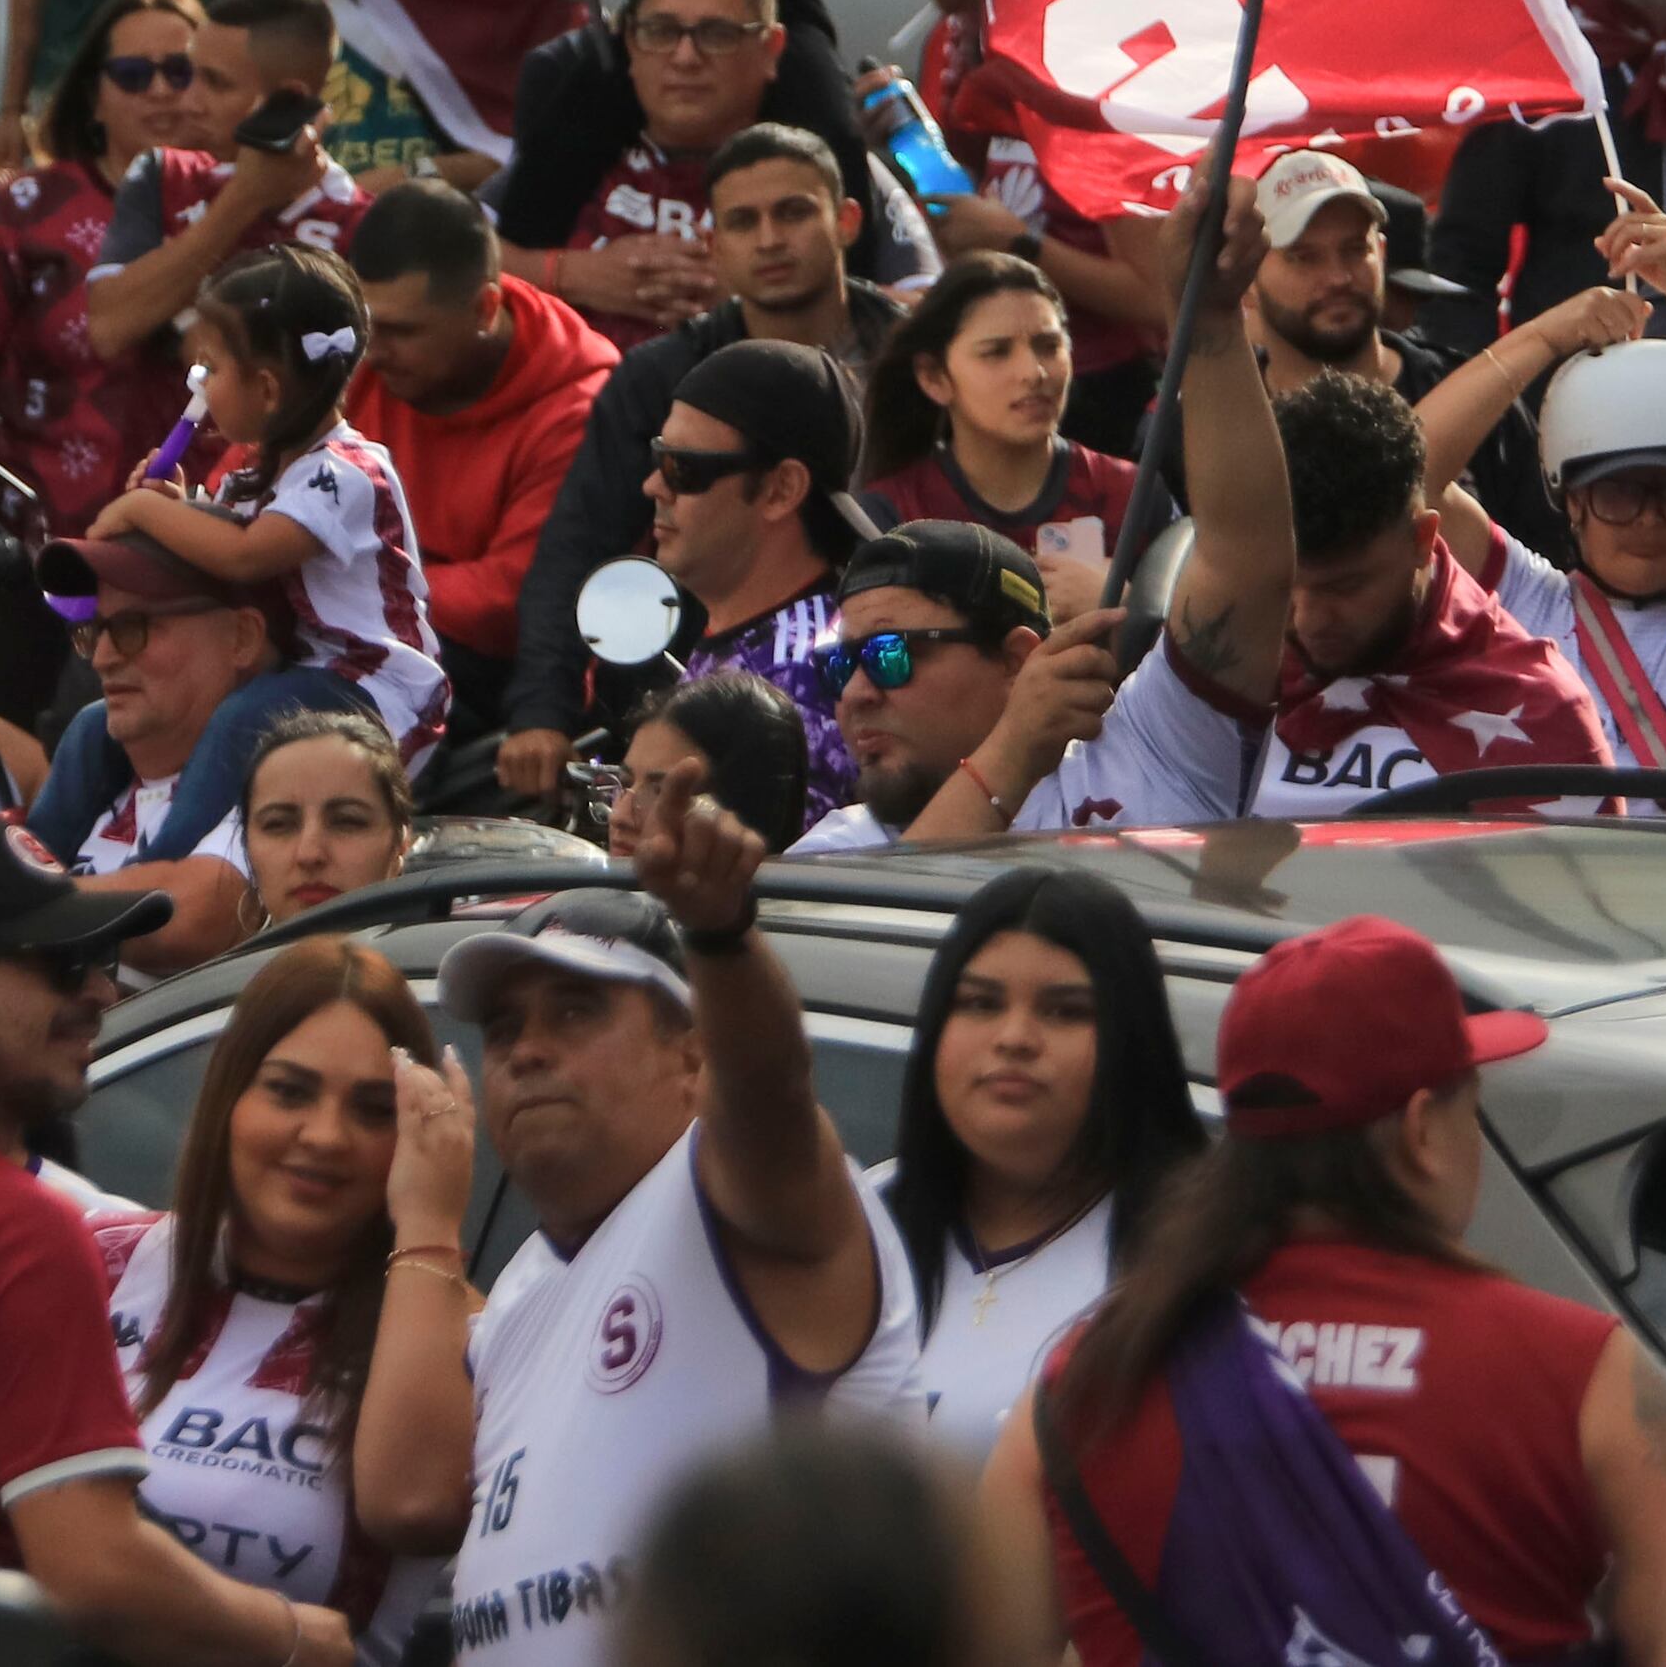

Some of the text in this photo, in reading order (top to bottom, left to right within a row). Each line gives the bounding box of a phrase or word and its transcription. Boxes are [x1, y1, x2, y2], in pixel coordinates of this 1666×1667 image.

[1280, 743, 1426, 790] BAC
[601, 1293, 637, 1371] S
[1276, 1318, 1422, 1390] CHEZ
[152, 1441, 323, 1492] CREDOMATIC
[159, 1405, 325, 1474] BAC
